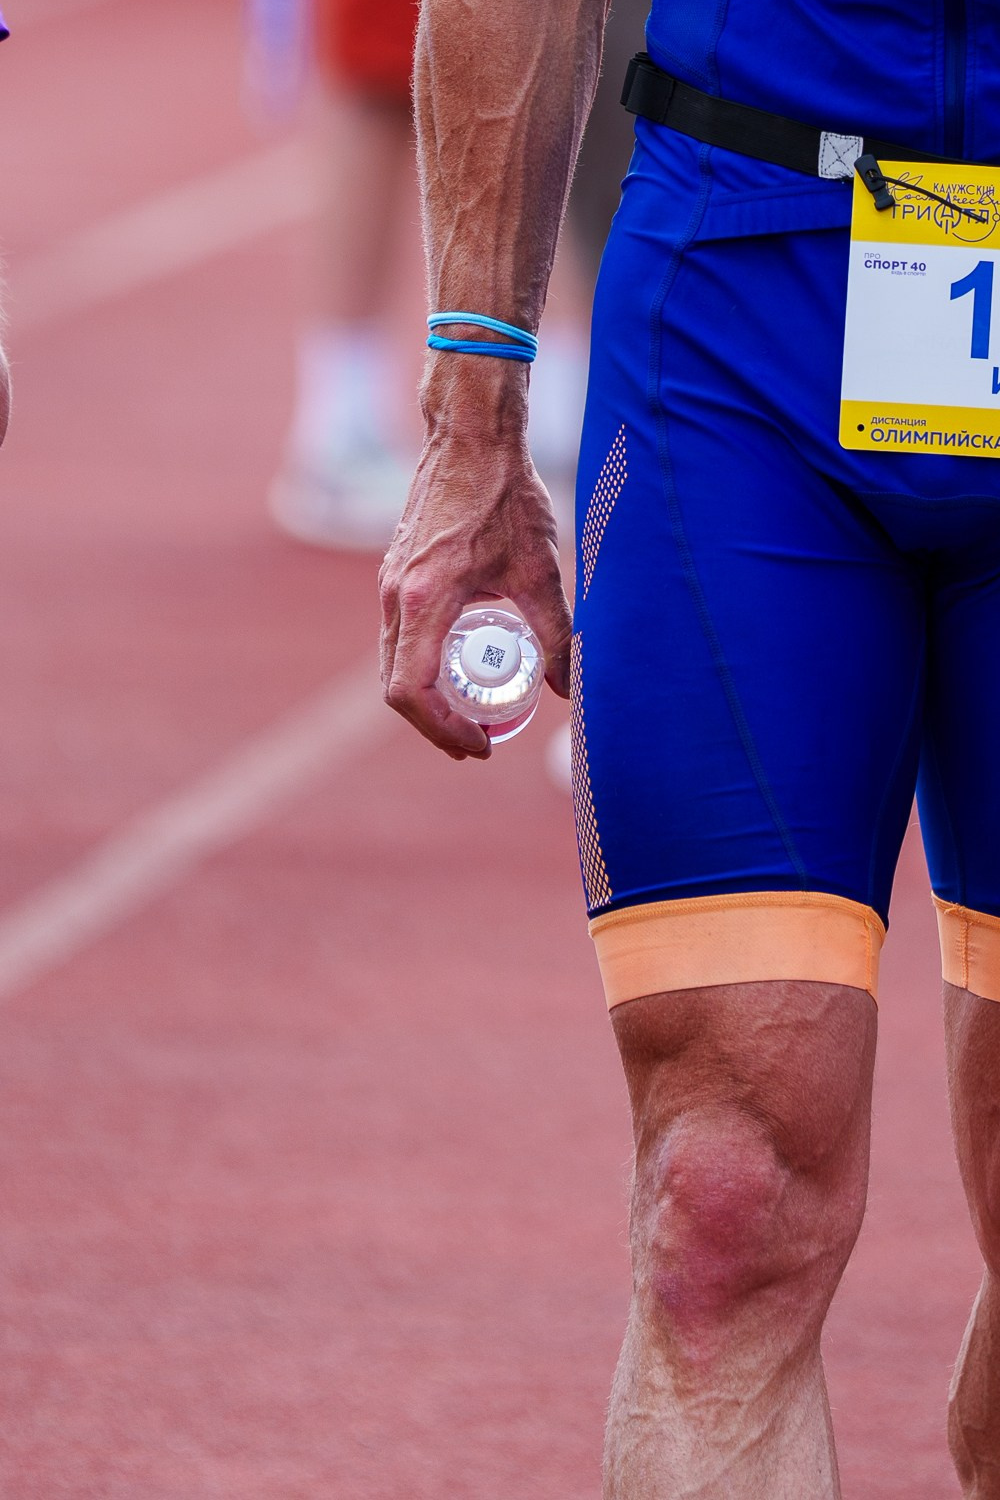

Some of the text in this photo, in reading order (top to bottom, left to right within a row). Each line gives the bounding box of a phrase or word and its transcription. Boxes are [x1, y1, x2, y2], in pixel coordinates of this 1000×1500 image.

[933, 182, 995, 196] КАЛУЖСКИЙ
[864, 252, 881, 260] ПРО
[864, 259, 927, 272] СПОРТ 40
[871, 416, 927, 427] ДИСТАНЦИЯ
